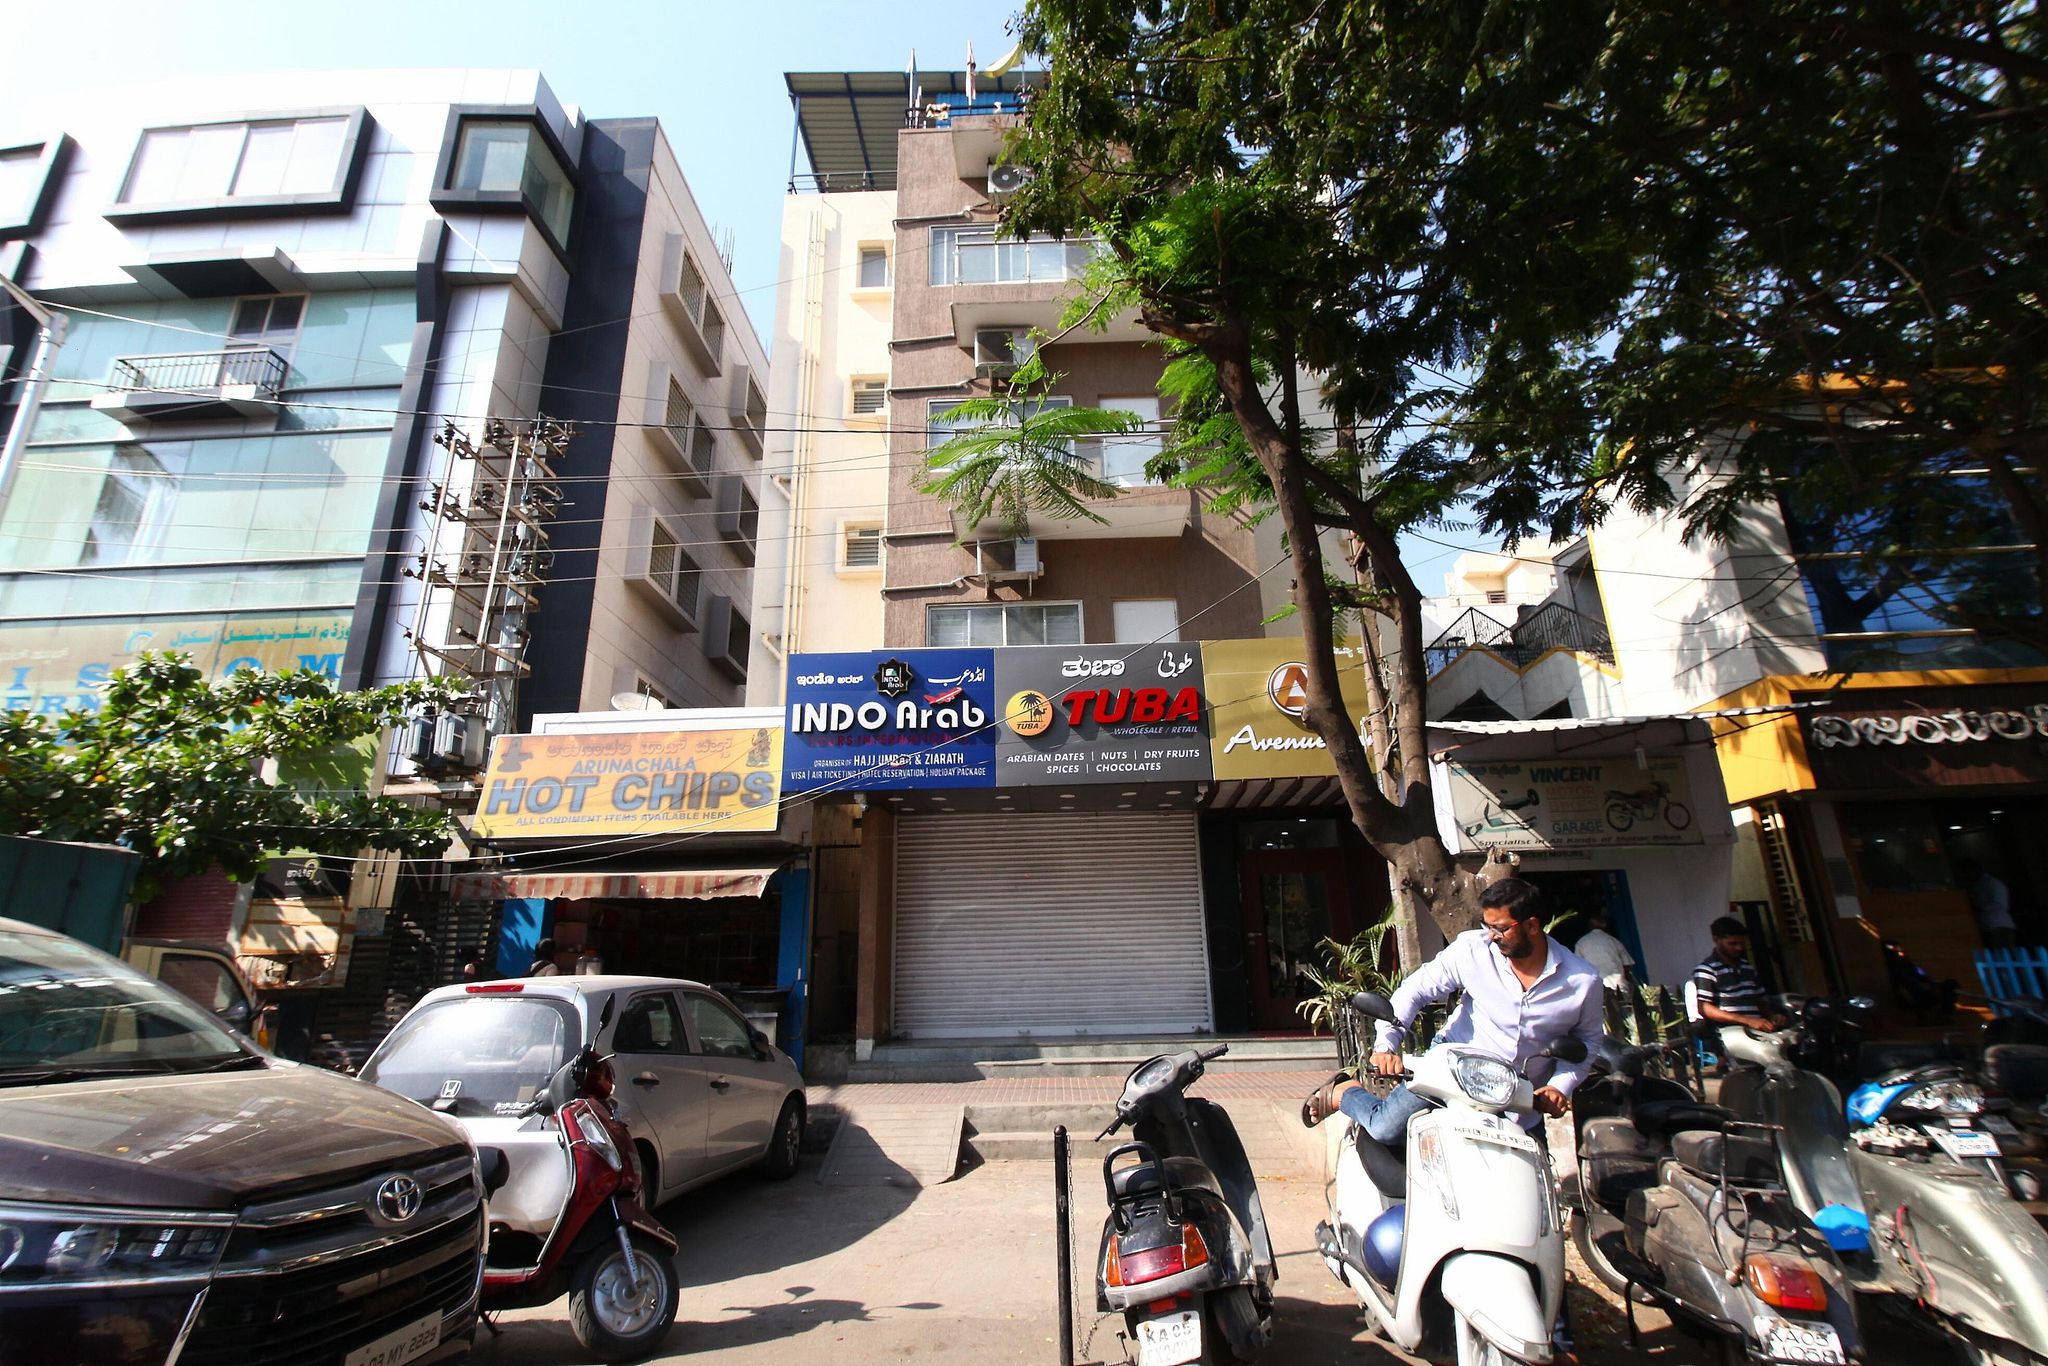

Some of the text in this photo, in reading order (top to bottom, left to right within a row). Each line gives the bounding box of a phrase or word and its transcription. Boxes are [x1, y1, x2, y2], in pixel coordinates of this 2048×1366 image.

[1061, 655, 1126, 678] ತುಬಾ
[1062, 687, 1200, 727] TUBA
[791, 700, 985, 733] INDO Arab
[1114, 727, 1163, 735] WHOLESALE
[1171, 725, 1198, 733] RETAIL
[853, 755, 876, 767] HAJJ
[925, 753, 964, 765] ZIARATH
[1007, 749, 1200, 763] ARABIAN DATES NUTS DRY FRUITS
[572, 757, 697, 775] ARUNACHALA
[1046, 763, 1162, 774] SPICES CHOCOLATES
[791, 771, 806, 780] VISA
[812, 771, 823, 779] AIR
[882, 768, 925, 778] RESERVATION
[956, 767, 986, 776] PACKAGE
[1530, 766, 1603, 783] VINCENT
[484, 770, 777, 816] HOT CHIPS
[516, 817, 539, 826] ALL
[702, 811, 732, 820] HERE
[1553, 820, 1605, 834] GARAGE
[1478, 838, 1532, 848] Specialist
